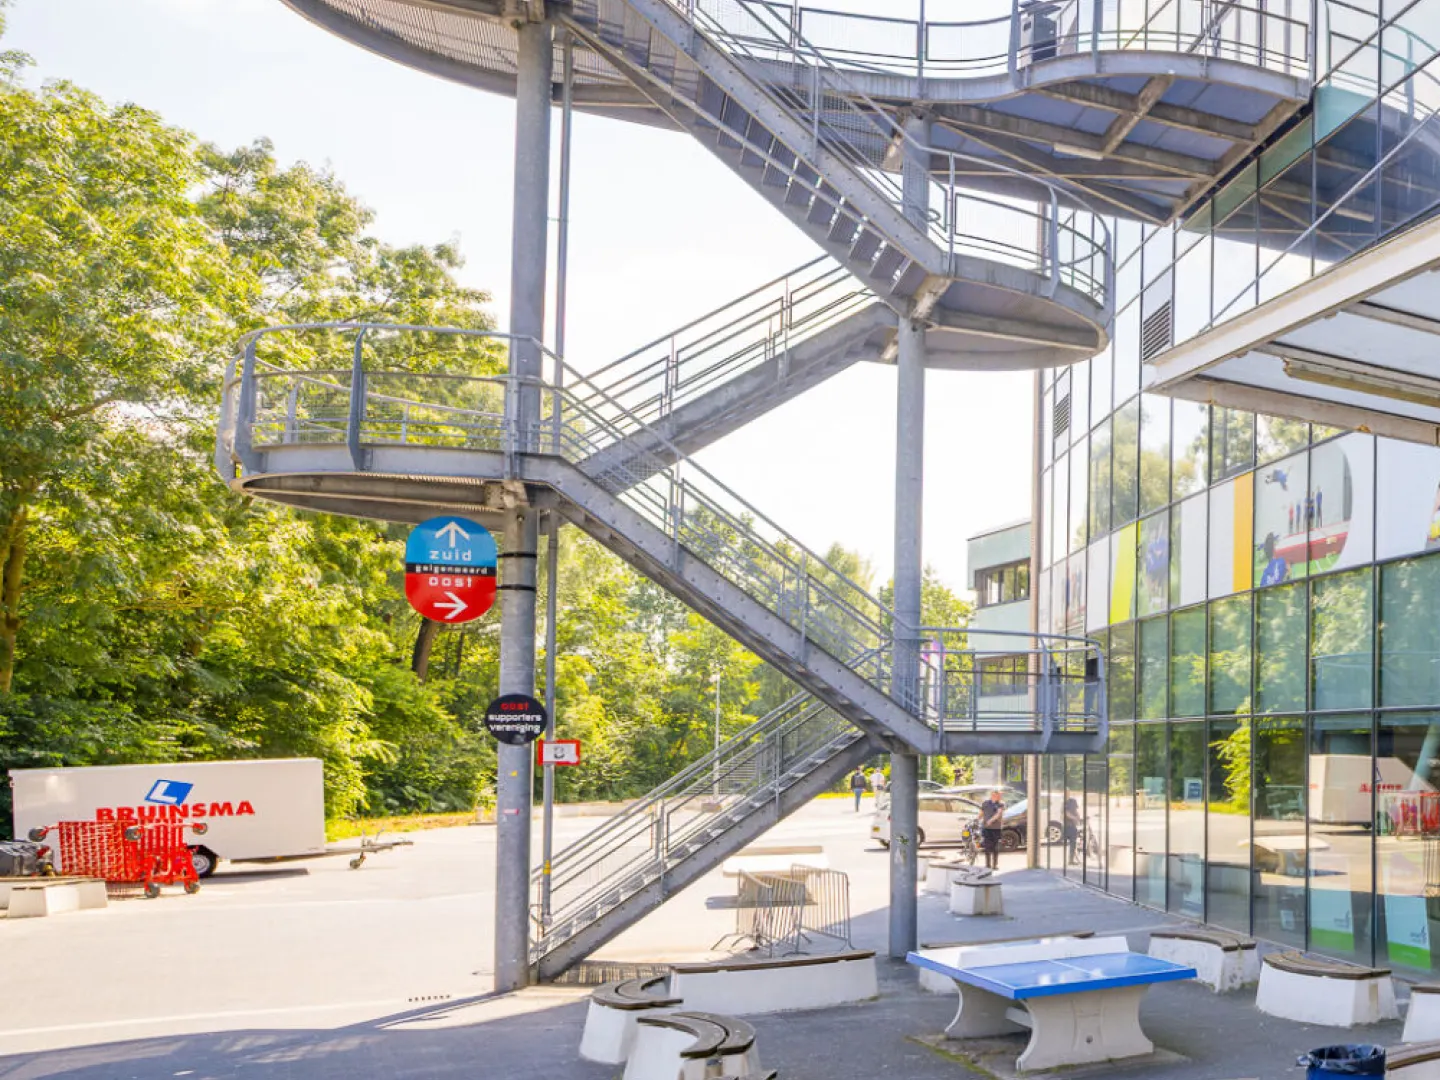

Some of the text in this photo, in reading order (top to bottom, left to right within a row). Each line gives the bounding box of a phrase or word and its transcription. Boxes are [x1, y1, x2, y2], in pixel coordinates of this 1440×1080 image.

[429, 549, 472, 561] zuid
[428, 576, 472, 588] oost
[501, 702, 529, 711] oost
[488, 713, 542, 722] supporters
[489, 724, 541, 734] vereniging
[96, 800, 255, 822] BRUINSMA
